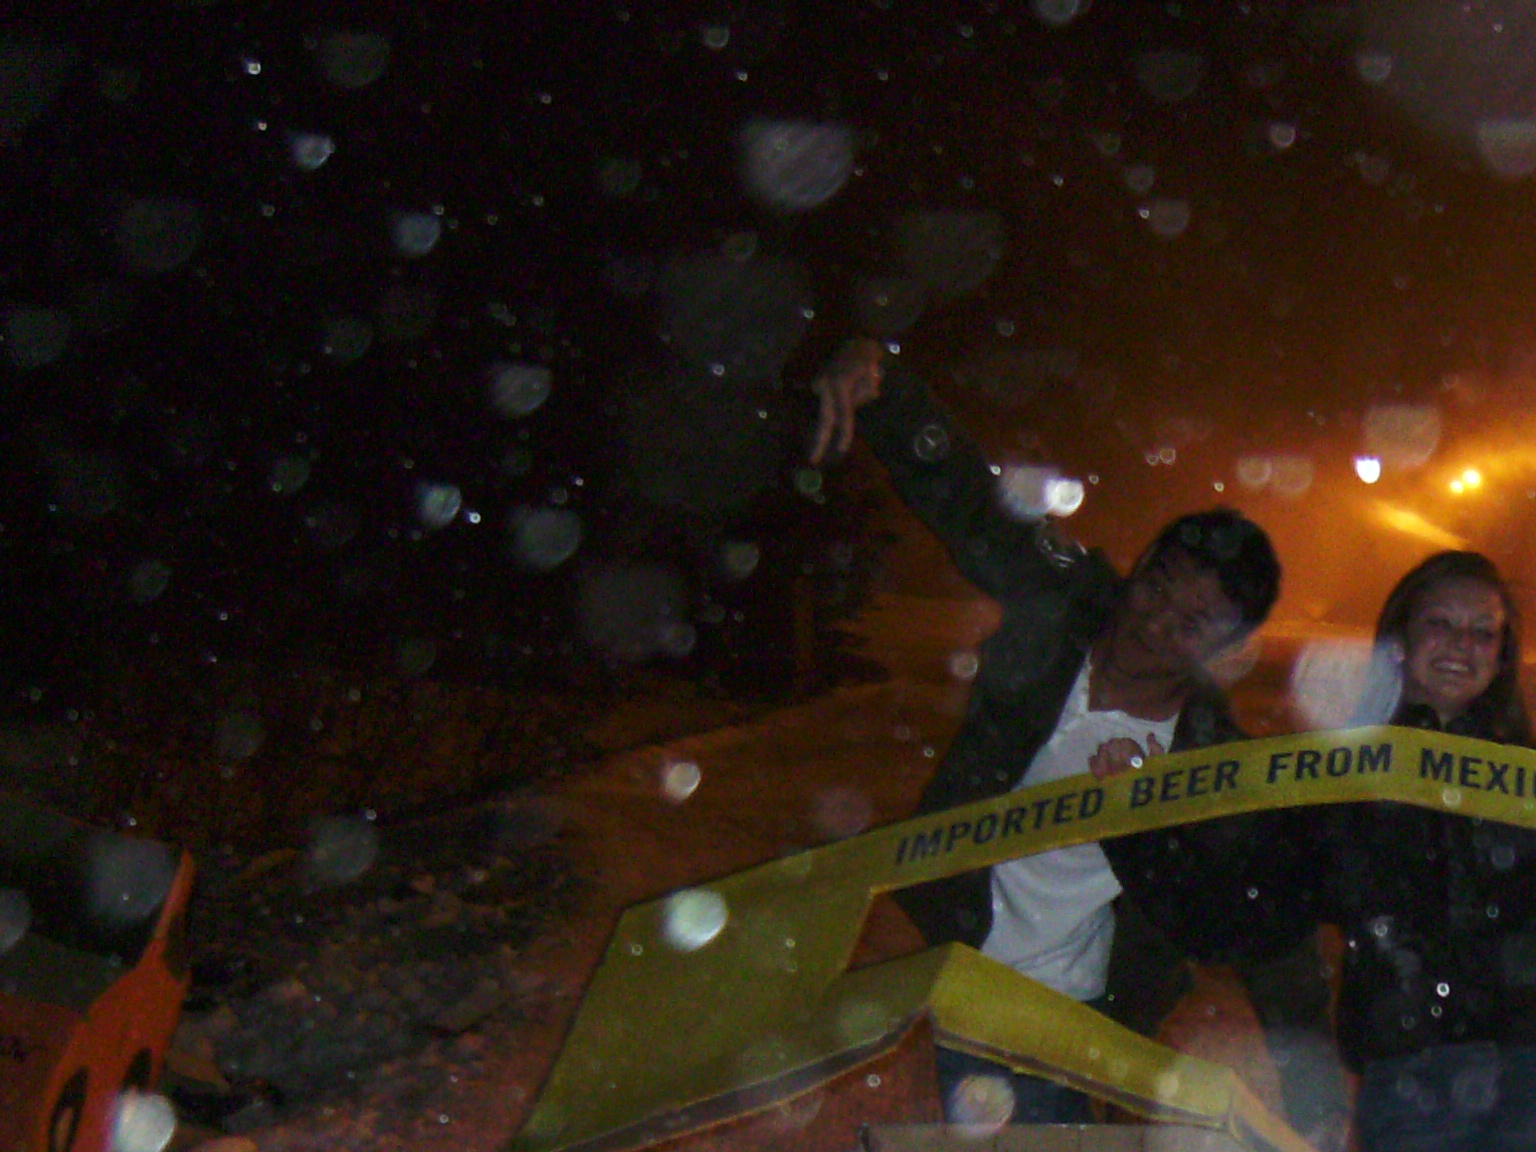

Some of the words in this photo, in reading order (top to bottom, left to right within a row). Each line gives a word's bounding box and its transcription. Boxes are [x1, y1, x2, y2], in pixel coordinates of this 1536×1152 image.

[895, 786, 1105, 866] IMPORTED
[1129, 758, 1240, 812] BEER
[1264, 742, 1393, 785] FROM
